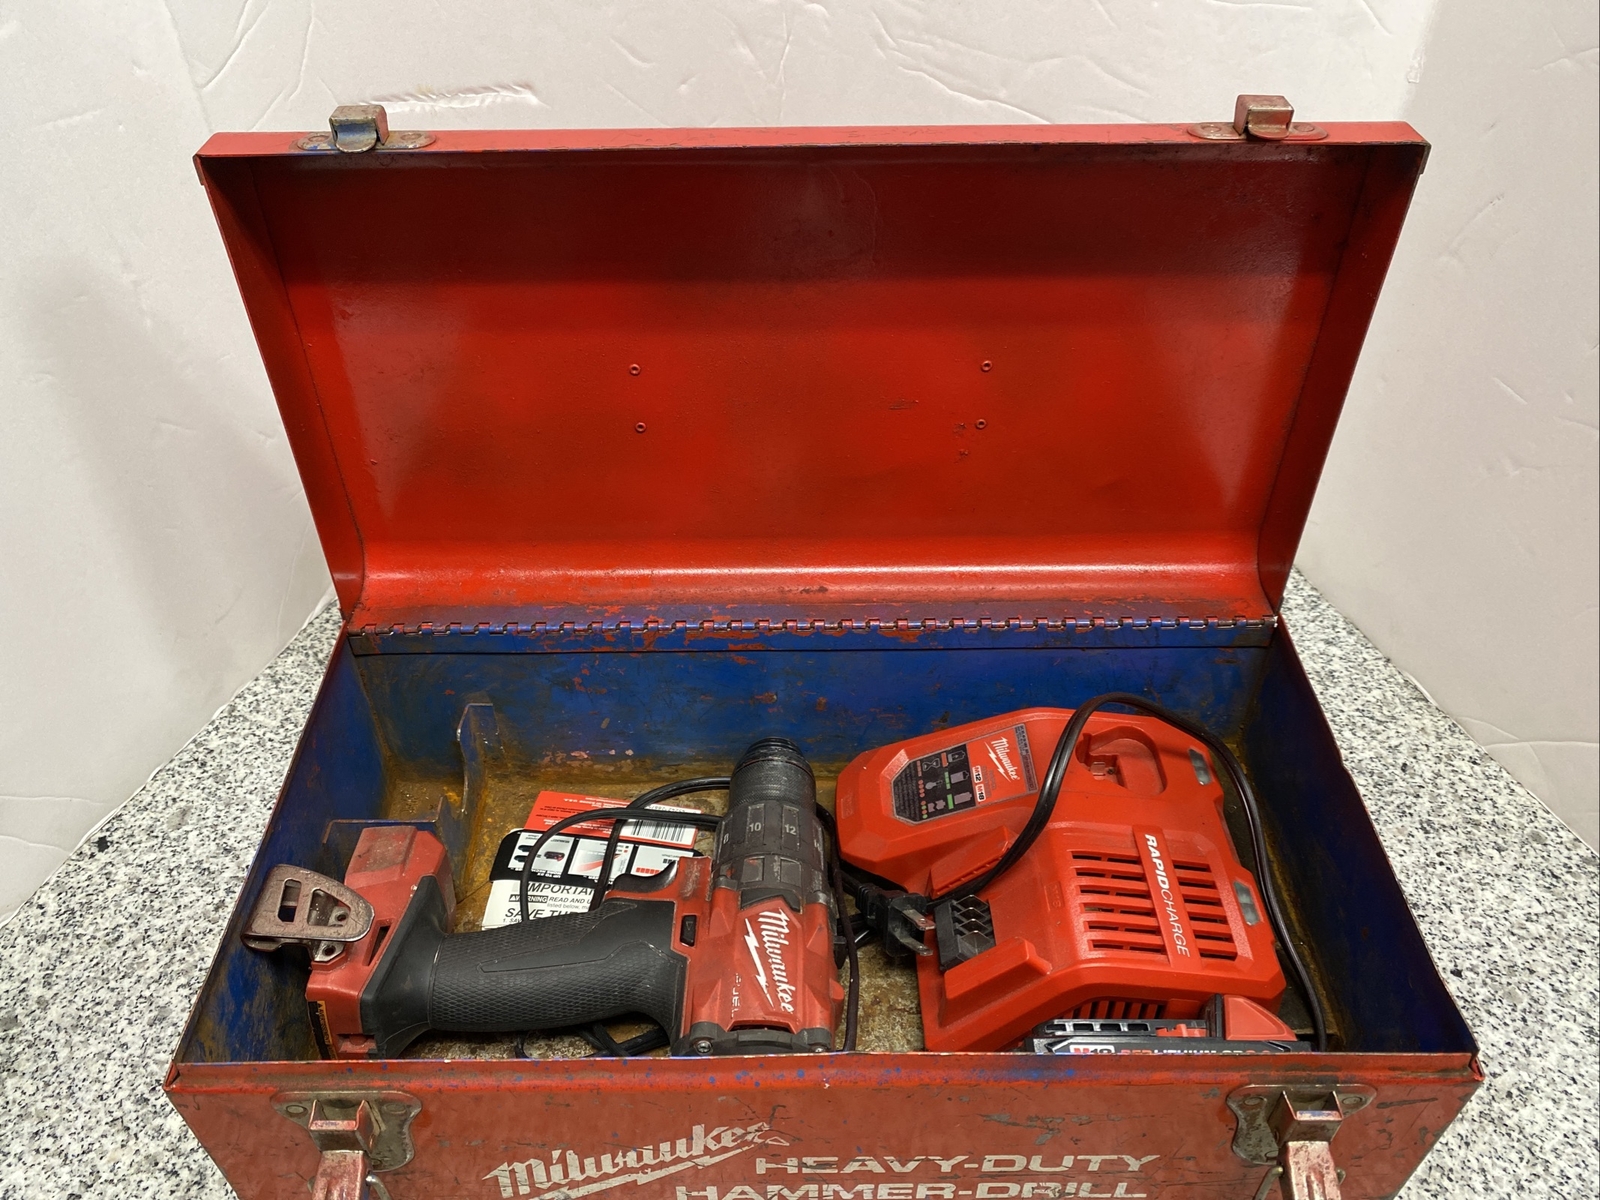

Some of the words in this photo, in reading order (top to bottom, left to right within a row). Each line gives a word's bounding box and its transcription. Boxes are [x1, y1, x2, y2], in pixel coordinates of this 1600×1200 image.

[991, 736, 1020, 781] Milwaukee
[749, 822, 761, 832] 10
[784, 824, 797, 835] 12
[758, 907, 796, 1014] Milwaukee
[482, 1121, 772, 1199] Milwaukee
[756, 1154, 1160, 1174] HEAVY-DUTY
[675, 1182, 1147, 1200] HAMMER-DRILL
